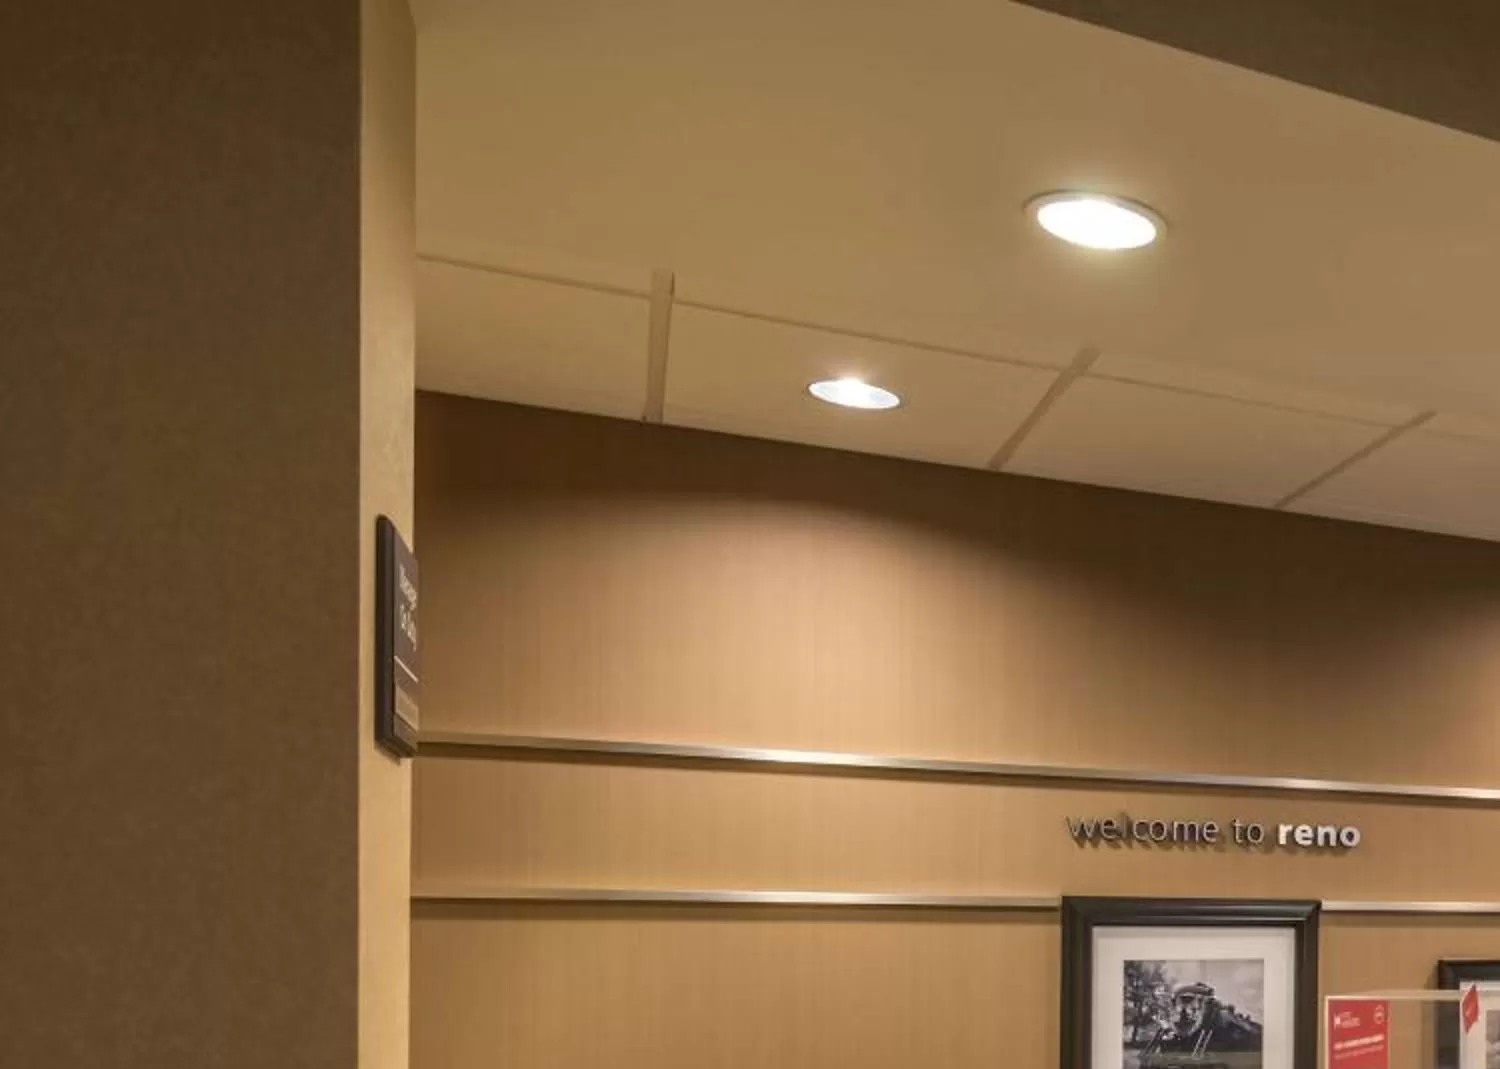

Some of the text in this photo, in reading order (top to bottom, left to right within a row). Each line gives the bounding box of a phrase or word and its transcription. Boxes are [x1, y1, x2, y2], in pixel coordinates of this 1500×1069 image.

[1065, 812, 1361, 848] welcome to reno
